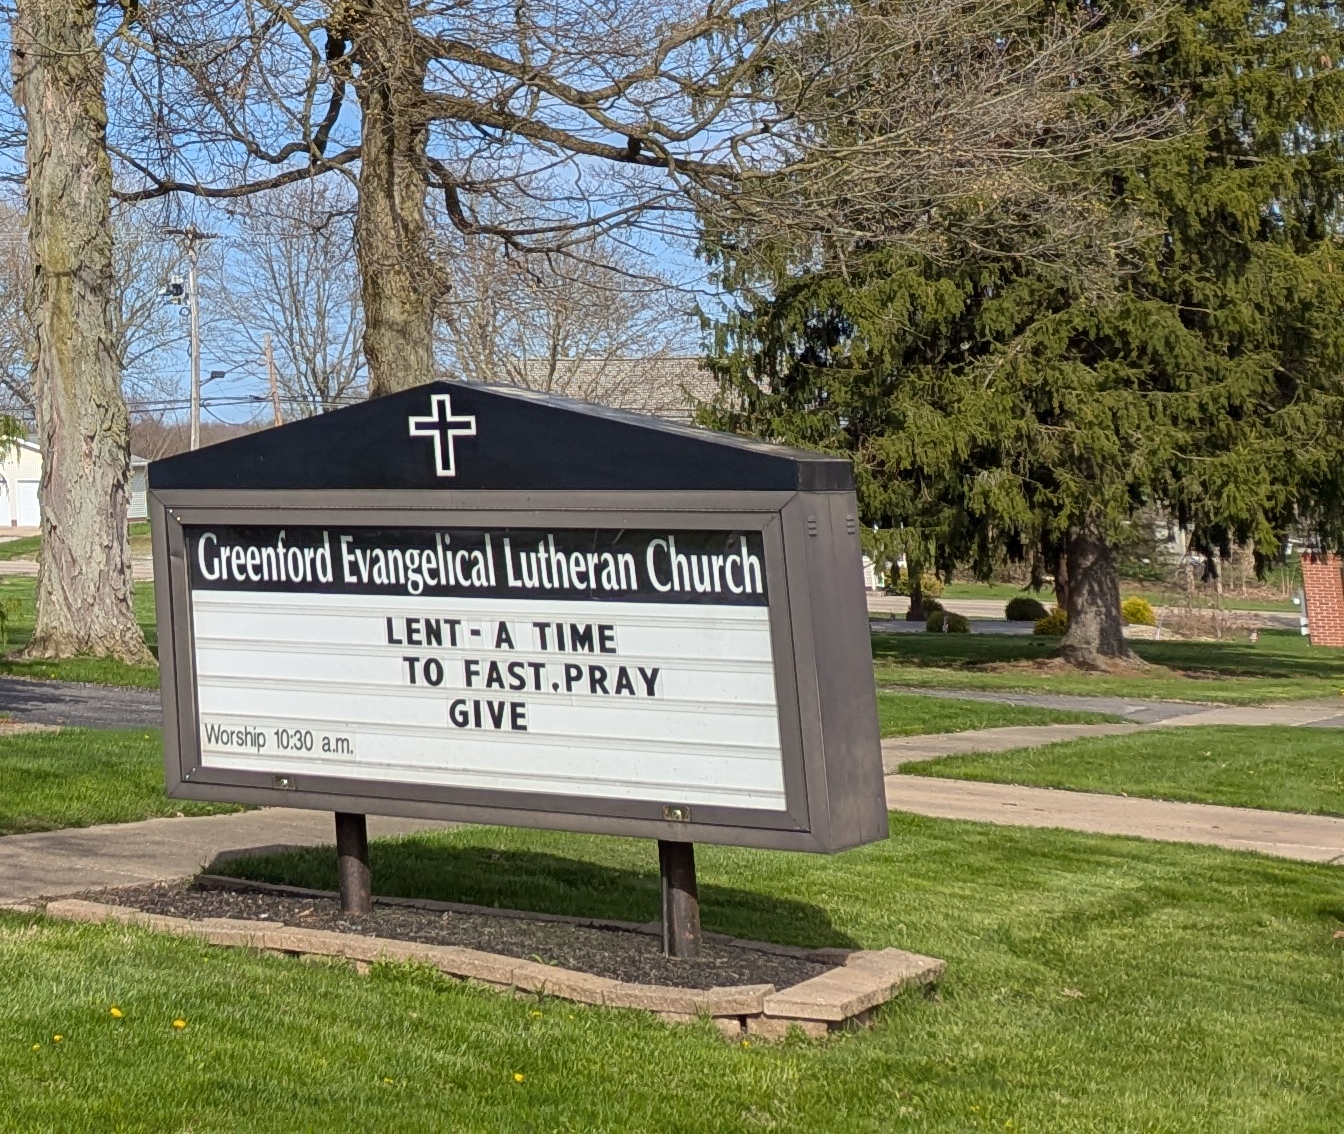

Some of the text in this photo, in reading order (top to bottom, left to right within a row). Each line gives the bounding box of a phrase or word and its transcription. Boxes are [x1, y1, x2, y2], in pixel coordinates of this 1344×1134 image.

[197, 530, 763, 595] Greenford Evangelical Lutheran Church
[495, 621, 515, 649] A
[532, 622, 617, 654] TIME
[402, 656, 444, 687] TO
[448, 698, 528, 731] GIVE
[204, 723, 354, 754] Worship 10:30 a.m.
